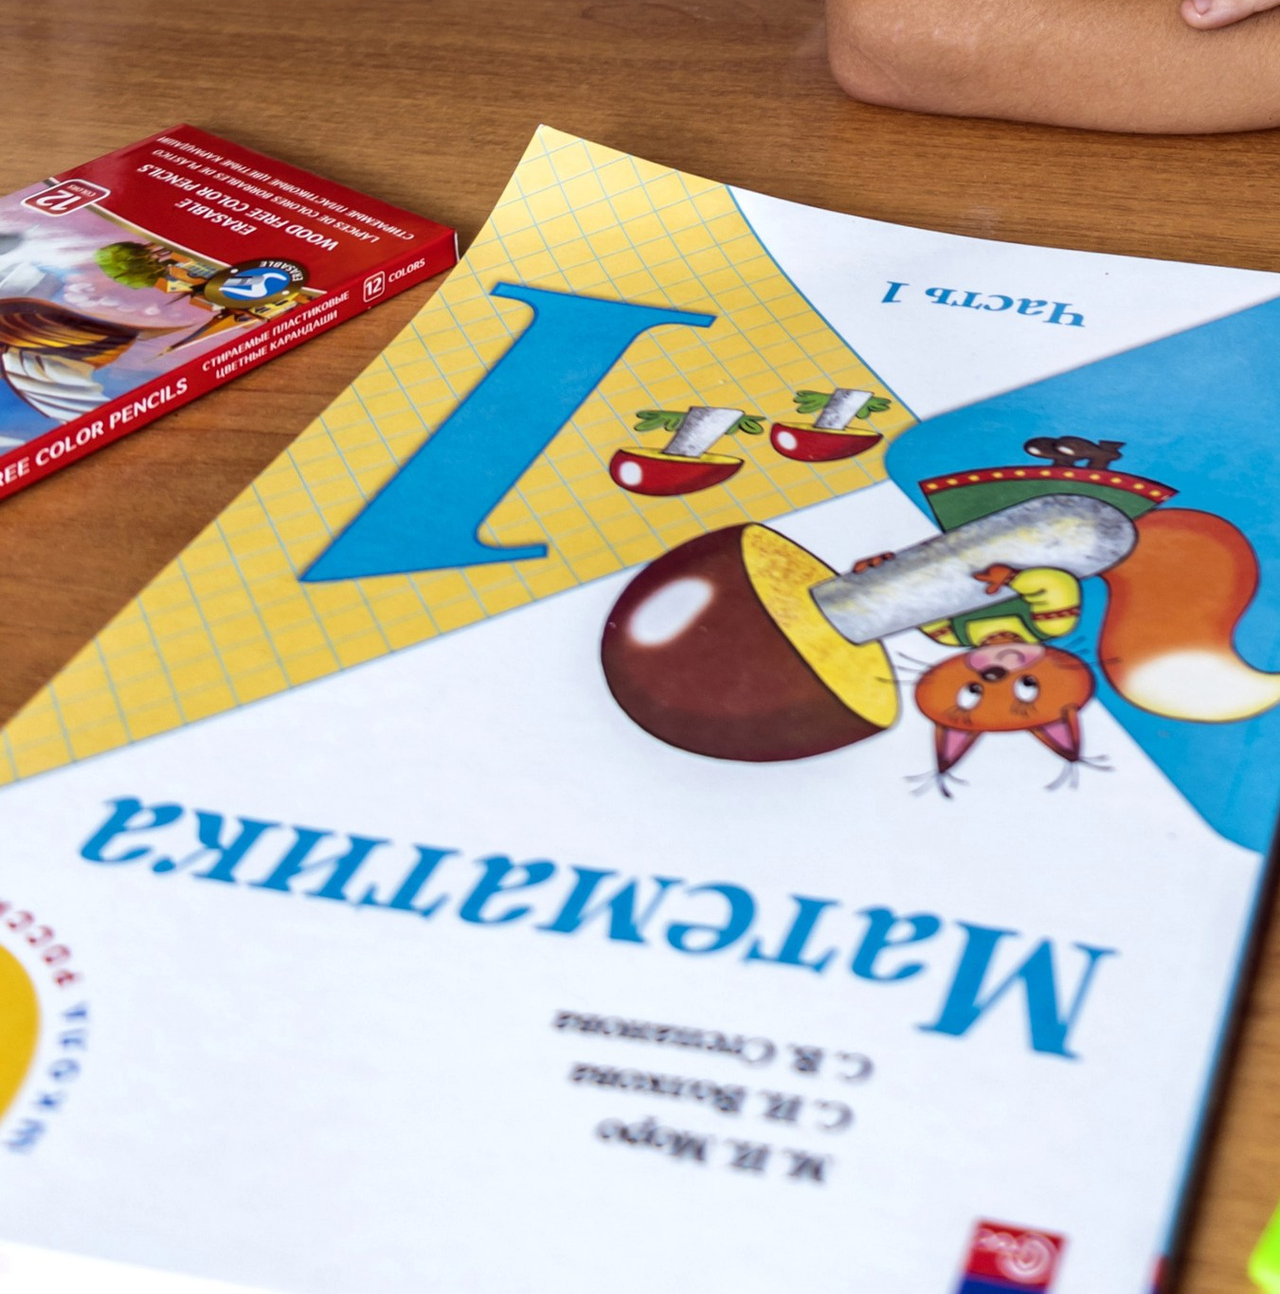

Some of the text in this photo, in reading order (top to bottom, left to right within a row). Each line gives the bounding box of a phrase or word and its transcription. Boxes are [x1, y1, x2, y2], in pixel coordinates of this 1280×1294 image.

[156, 136, 415, 241] СТИРАЕМЫЕ ПЛАСТИКОВЫЕ ЦВЕТНЫЕ КАРАНДАШИ
[199, 168, 217, 178] DE
[217, 175, 276, 201] BORRABLES
[36, 189, 82, 211] 12
[137, 164, 339, 251] WOOD FREE COLOR PENCILS
[174, 198, 258, 236] ERASABLE
[274, 197, 315, 214] COLORES
[316, 212, 334, 223] DE
[259, 261, 304, 281] ERASABLE
[365, 258, 426, 297] 12 COLORS
[880, 280, 1086, 328] Часть 1
[202, 290, 350, 372] СТИРАЕМЫЕ ПЛАСТИКОВЫЕ
[215, 309, 339, 380] ЦВЕТНЫЕ КАРАНДАШИ
[35, 420, 104, 466] COLOR
[109, 377, 189, 430] PENCILS
[298, 281, 716, 583] 1
[78, 794, 1118, 1061] Математика
[552, 1009, 778, 1068] Степанова
[569, 1061, 748, 1115] Волкова
[834, 1050, 876, 1083] С.
[814, 1099, 856, 1133] С.
[594, 1114, 712, 1164] Моро
[781, 1148, 832, 1184] М.
